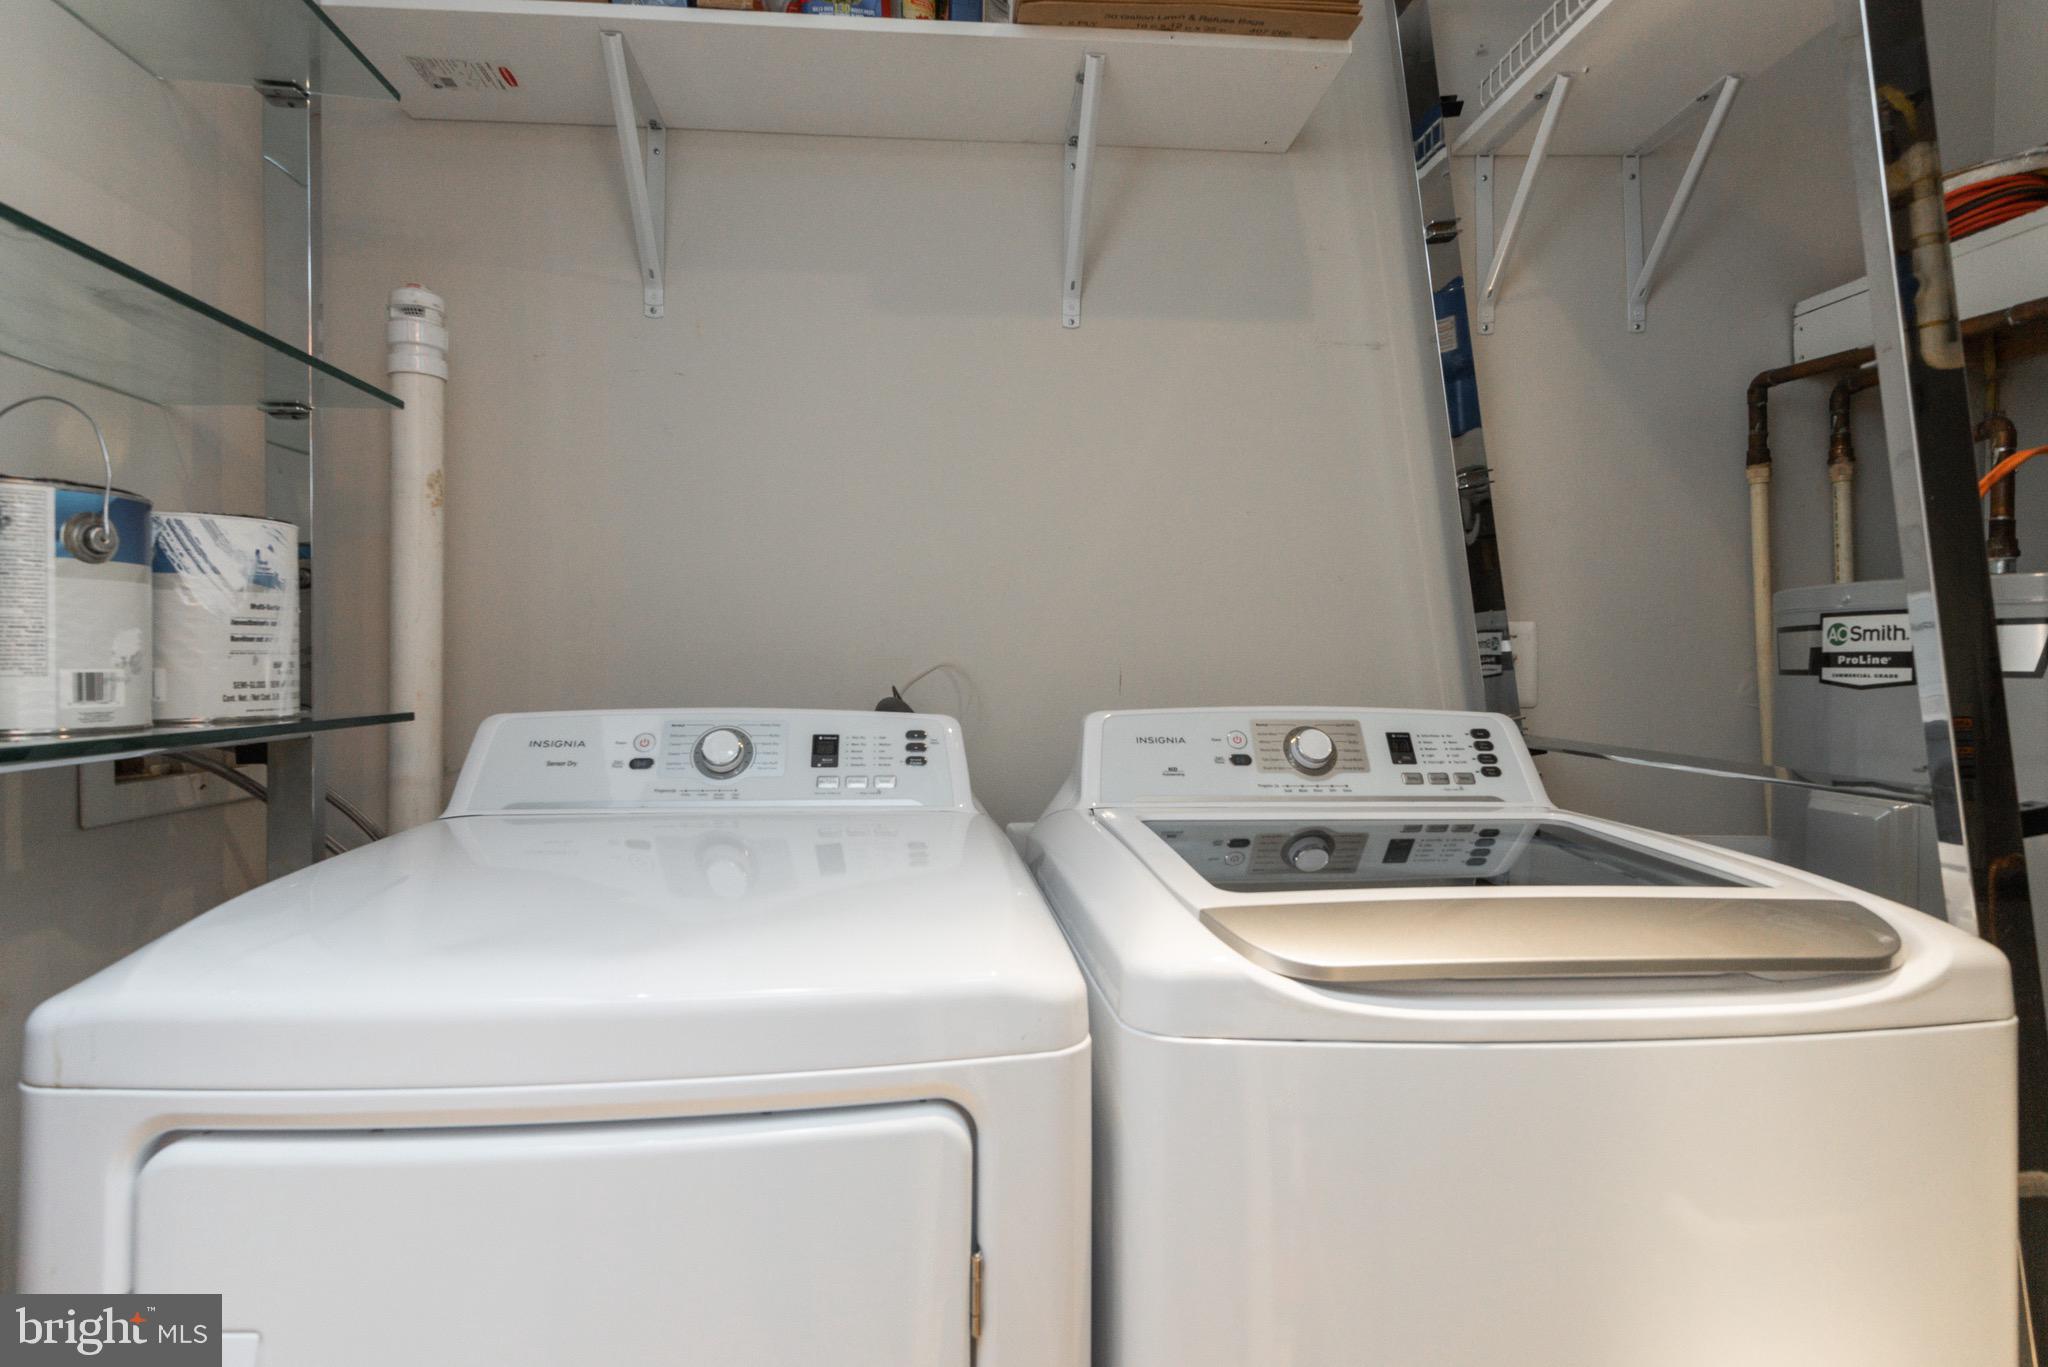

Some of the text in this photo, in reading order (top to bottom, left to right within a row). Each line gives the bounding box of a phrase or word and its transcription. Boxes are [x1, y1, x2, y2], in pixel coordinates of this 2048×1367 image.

[1187, 13, 1196, 22] &
[1199, 14, 1235, 24] Refuse
[1837, 655, 1889, 666] ProLine
[529, 740, 586, 749] INSIGNIA
[1135, 736, 1186, 745] INSIGNIA
[567, 760, 578, 769] Dry
